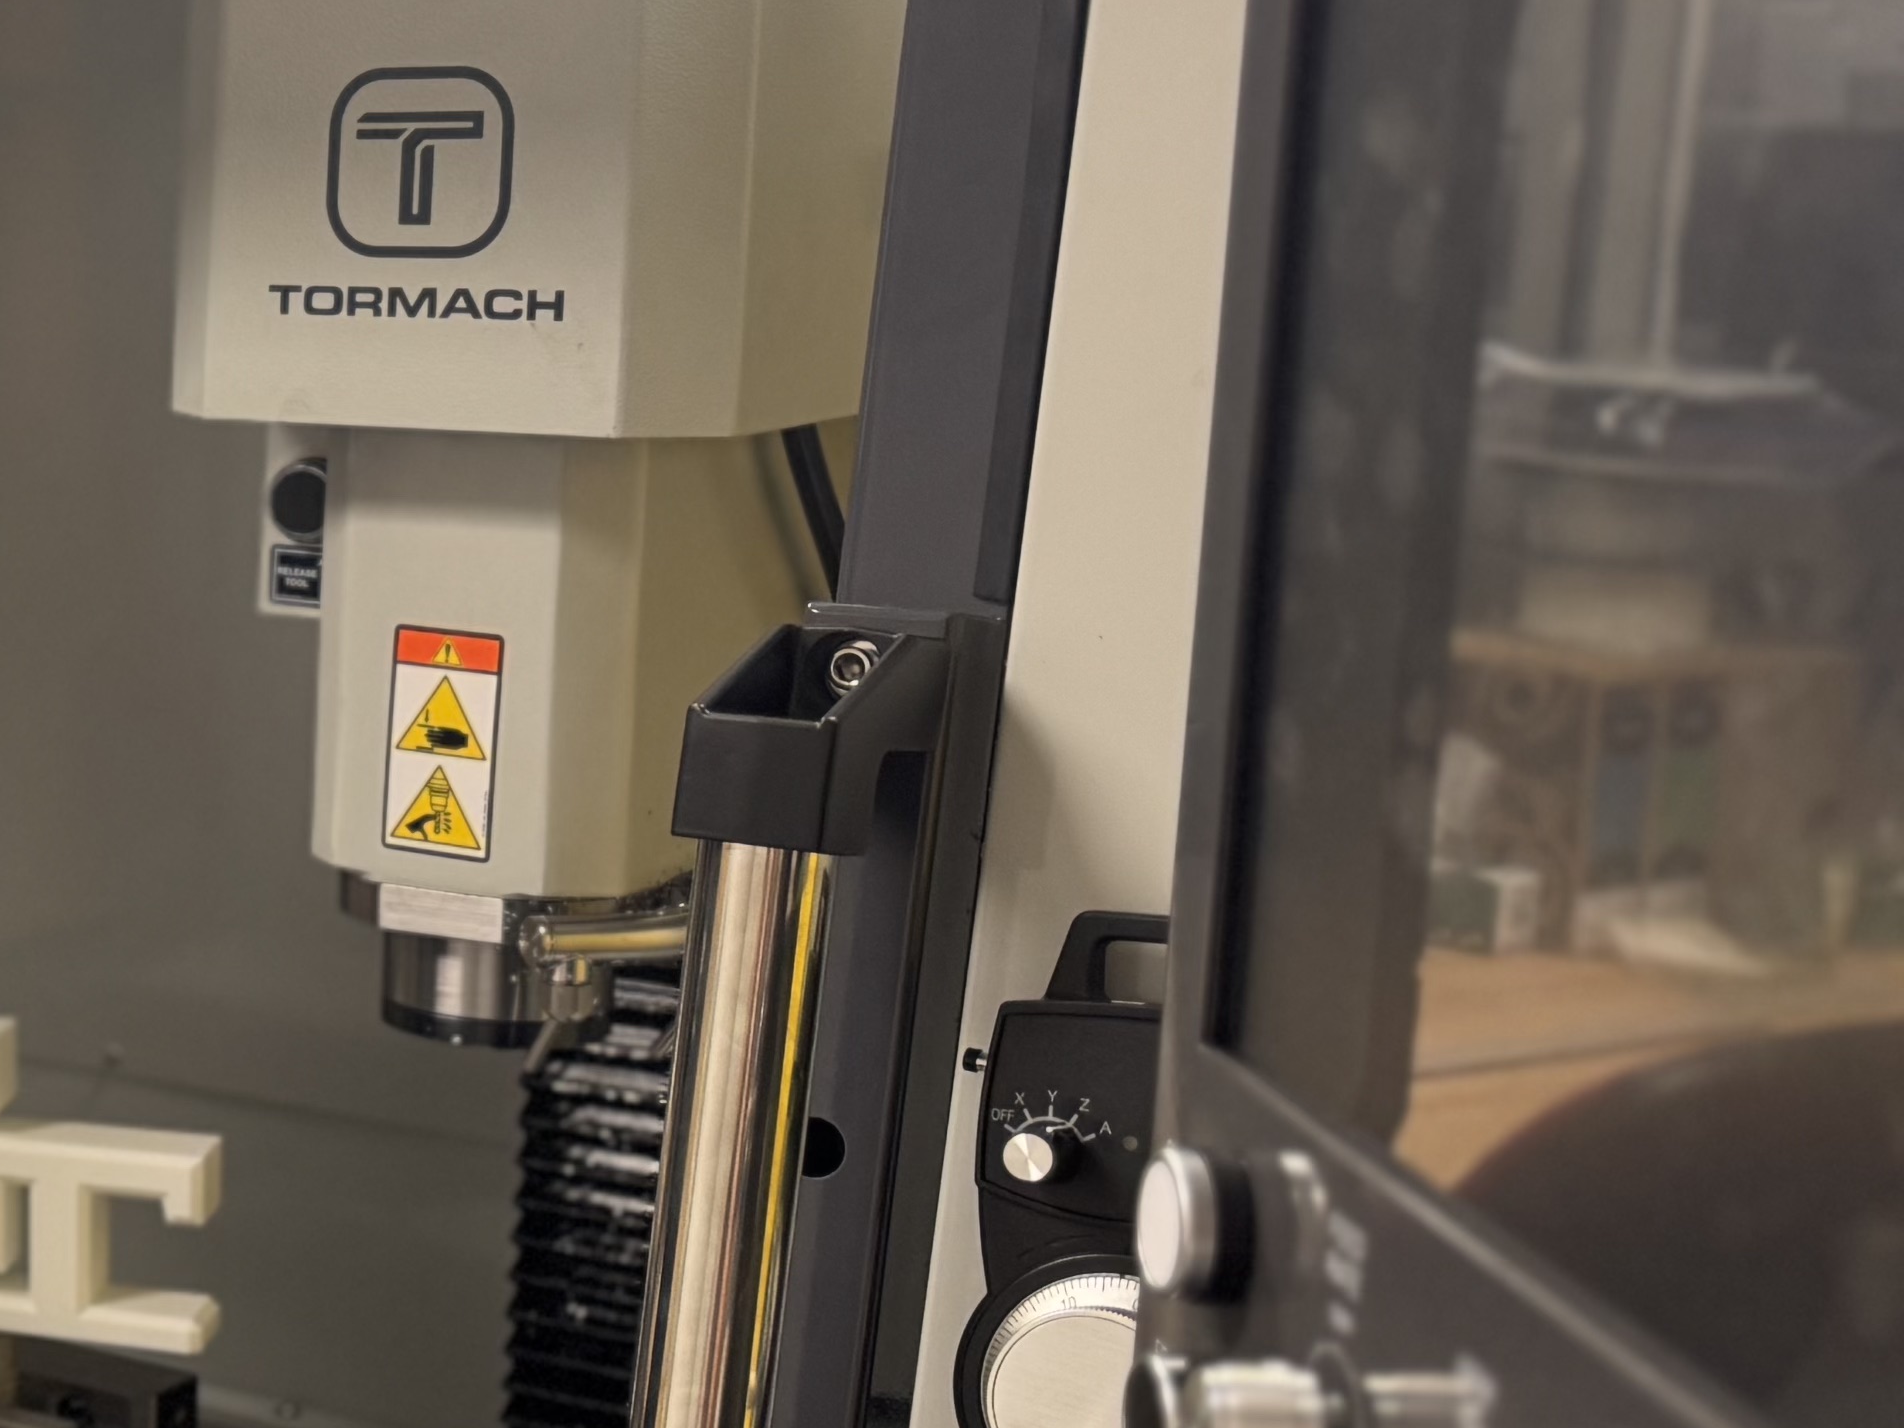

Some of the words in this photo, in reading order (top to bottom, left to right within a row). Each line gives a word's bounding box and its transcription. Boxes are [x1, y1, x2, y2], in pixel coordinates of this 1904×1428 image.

[268, 283, 566, 322] TORMACH
[285, 577, 310, 588] TOOL
[1014, 1091, 1025, 1105] X
[1047, 1089, 1058, 1103] Y
[1079, 1097, 1090, 1112] Z
[991, 1107, 1015, 1122] OFF
[1099, 1121, 1112, 1135] A
